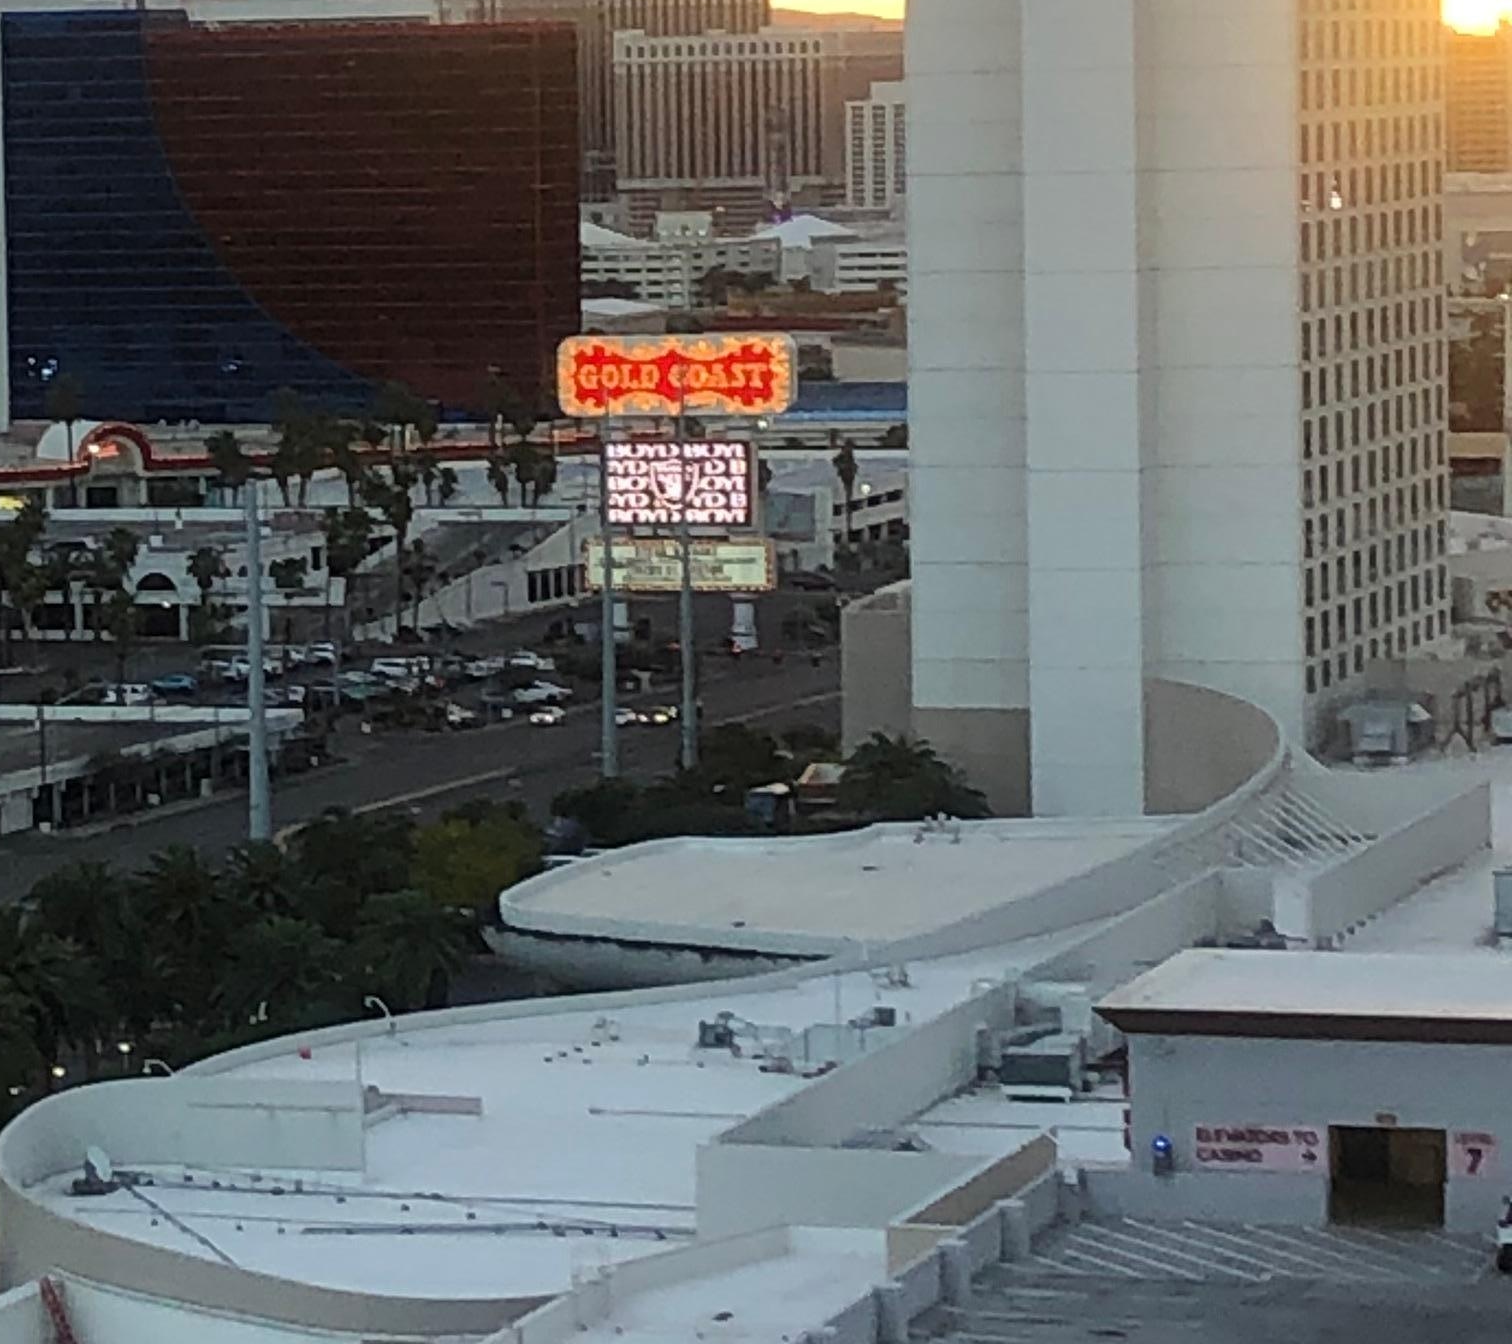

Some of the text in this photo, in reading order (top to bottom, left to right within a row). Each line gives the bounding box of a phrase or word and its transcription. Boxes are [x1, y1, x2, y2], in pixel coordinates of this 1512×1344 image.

[579, 363, 768, 390] GOLD COAST
[1466, 1148, 1483, 1175] 7
